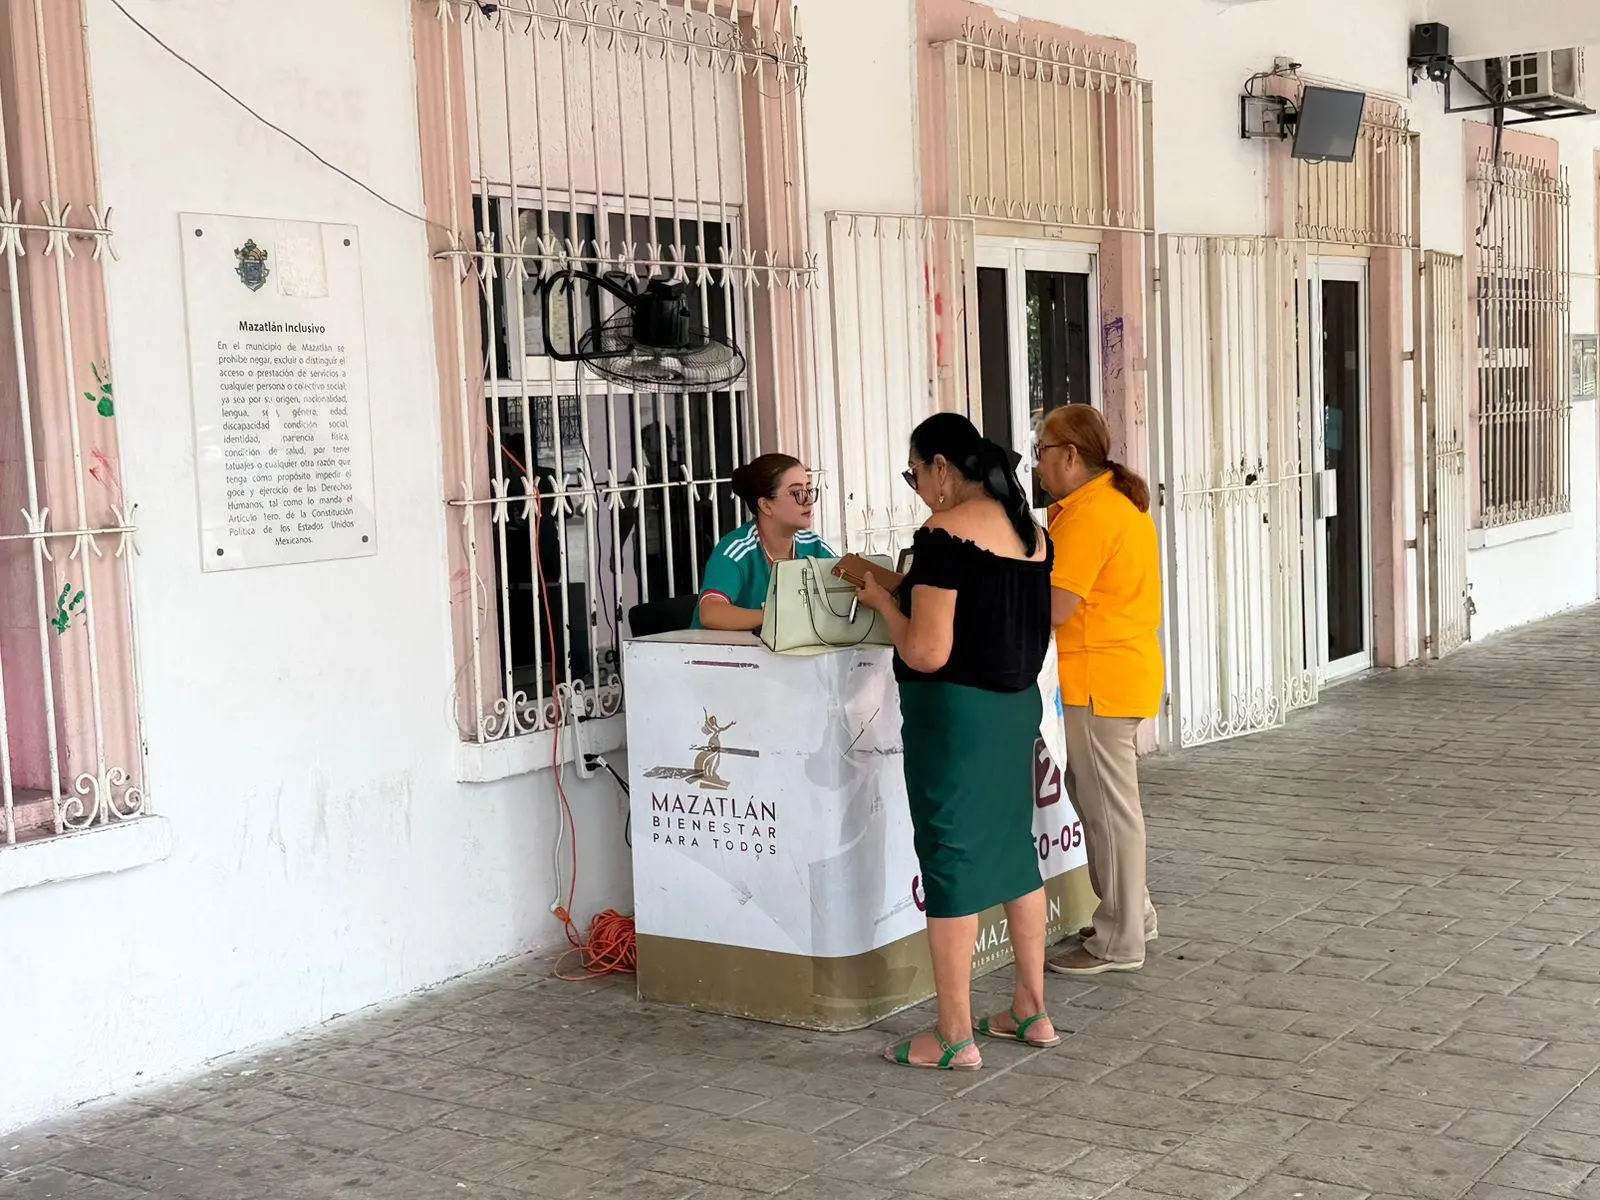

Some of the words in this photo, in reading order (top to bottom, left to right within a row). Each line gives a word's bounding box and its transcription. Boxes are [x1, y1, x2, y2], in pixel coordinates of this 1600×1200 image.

[240, 321, 282, 332] Mazatlán
[285, 323, 325, 333] Inclusivo
[233, 342, 240, 350] el
[246, 342, 281, 352] municipio
[288, 343, 296, 351] de
[250, 356, 272, 366] negar,
[257, 370, 294, 378] prestación
[220, 382, 254, 391] cualquier
[257, 383, 285, 391] persona
[221, 397, 229, 405] ya
[249, 396, 260, 405] por
[276, 396, 300, 404] origen,
[222, 409, 249, 418] lengua,
[224, 434, 260, 444] identidad,
[226, 462, 254, 471] tatuajes
[265, 459, 297, 469] cualquier
[317, 459, 335, 467] razón
[226, 476, 247, 485] tenga
[278, 472, 310, 482] propósito
[227, 489, 244, 498] goce
[260, 487, 288, 496] ejercicio
[294, 485, 302, 493] de
[322, 483, 352, 492] Derechos
[228, 501, 264, 510] Humanos,
[269, 499, 278, 508] tal
[320, 496, 342, 504] manda
[300, 510, 306, 518] la
[312, 508, 353, 517] Constitución
[264, 525, 272, 533] de
[298, 523, 324, 531] Estados
[331, 520, 354, 529] Unidos
[652, 792, 776, 822] MAZATLÁN
[653, 816, 776, 838] BIENESTAR
[653, 833, 699, 847] PARA
[713, 839, 776, 855] TODOS
[1033, 821, 1081, 860] 0-05
